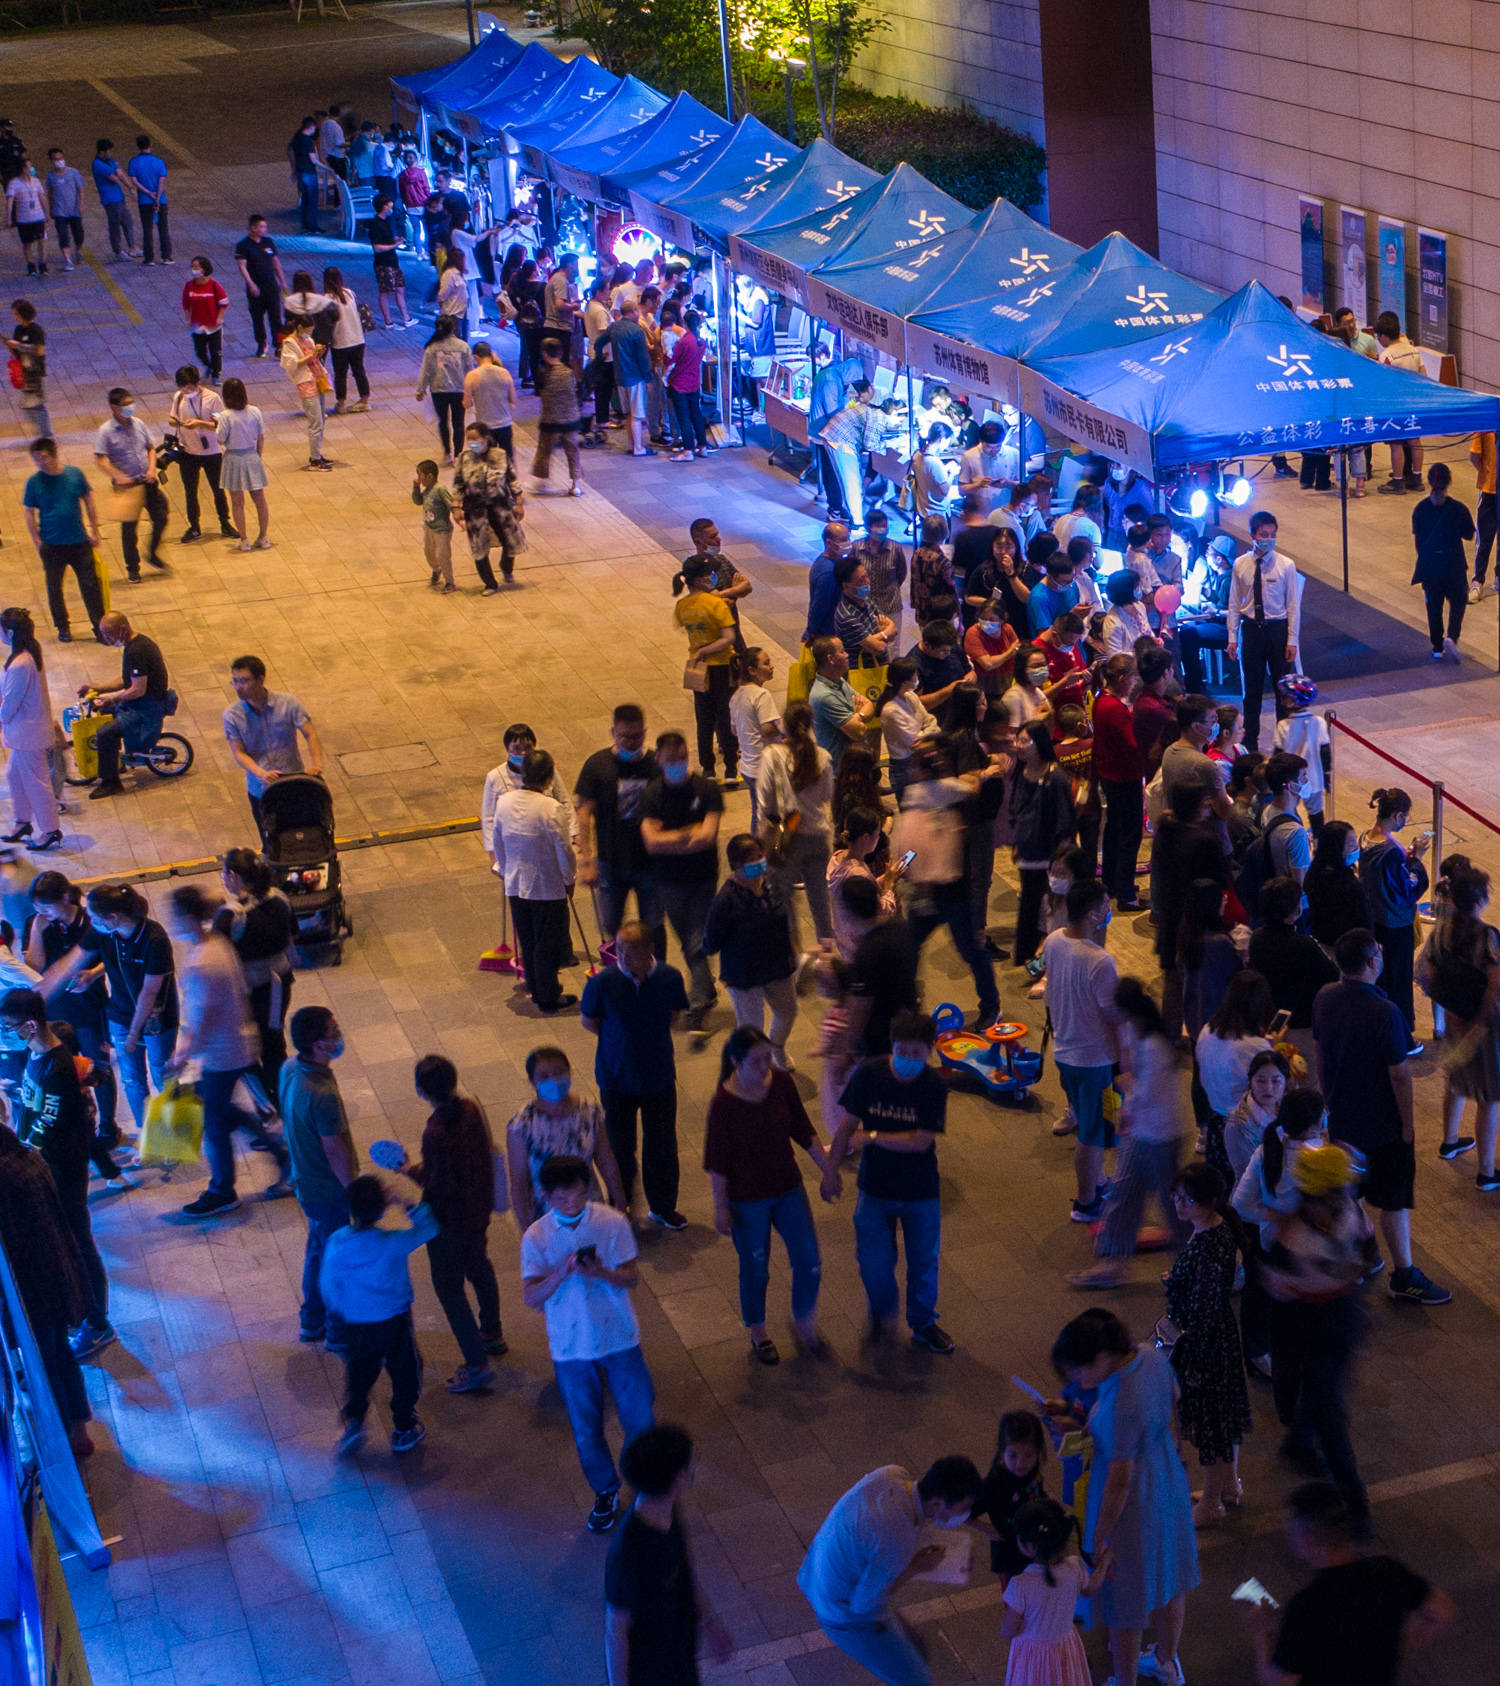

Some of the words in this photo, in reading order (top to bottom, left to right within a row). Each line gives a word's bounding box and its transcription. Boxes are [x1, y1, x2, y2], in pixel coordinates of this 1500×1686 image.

[933, 343, 991, 386] 苏州体育博物馆
[1256, 377, 1354, 393] 中国体育彩票
[1043, 389, 1128, 455] 苏州市民卡有限公司
[1236, 420, 1323, 447] 公益体彩
